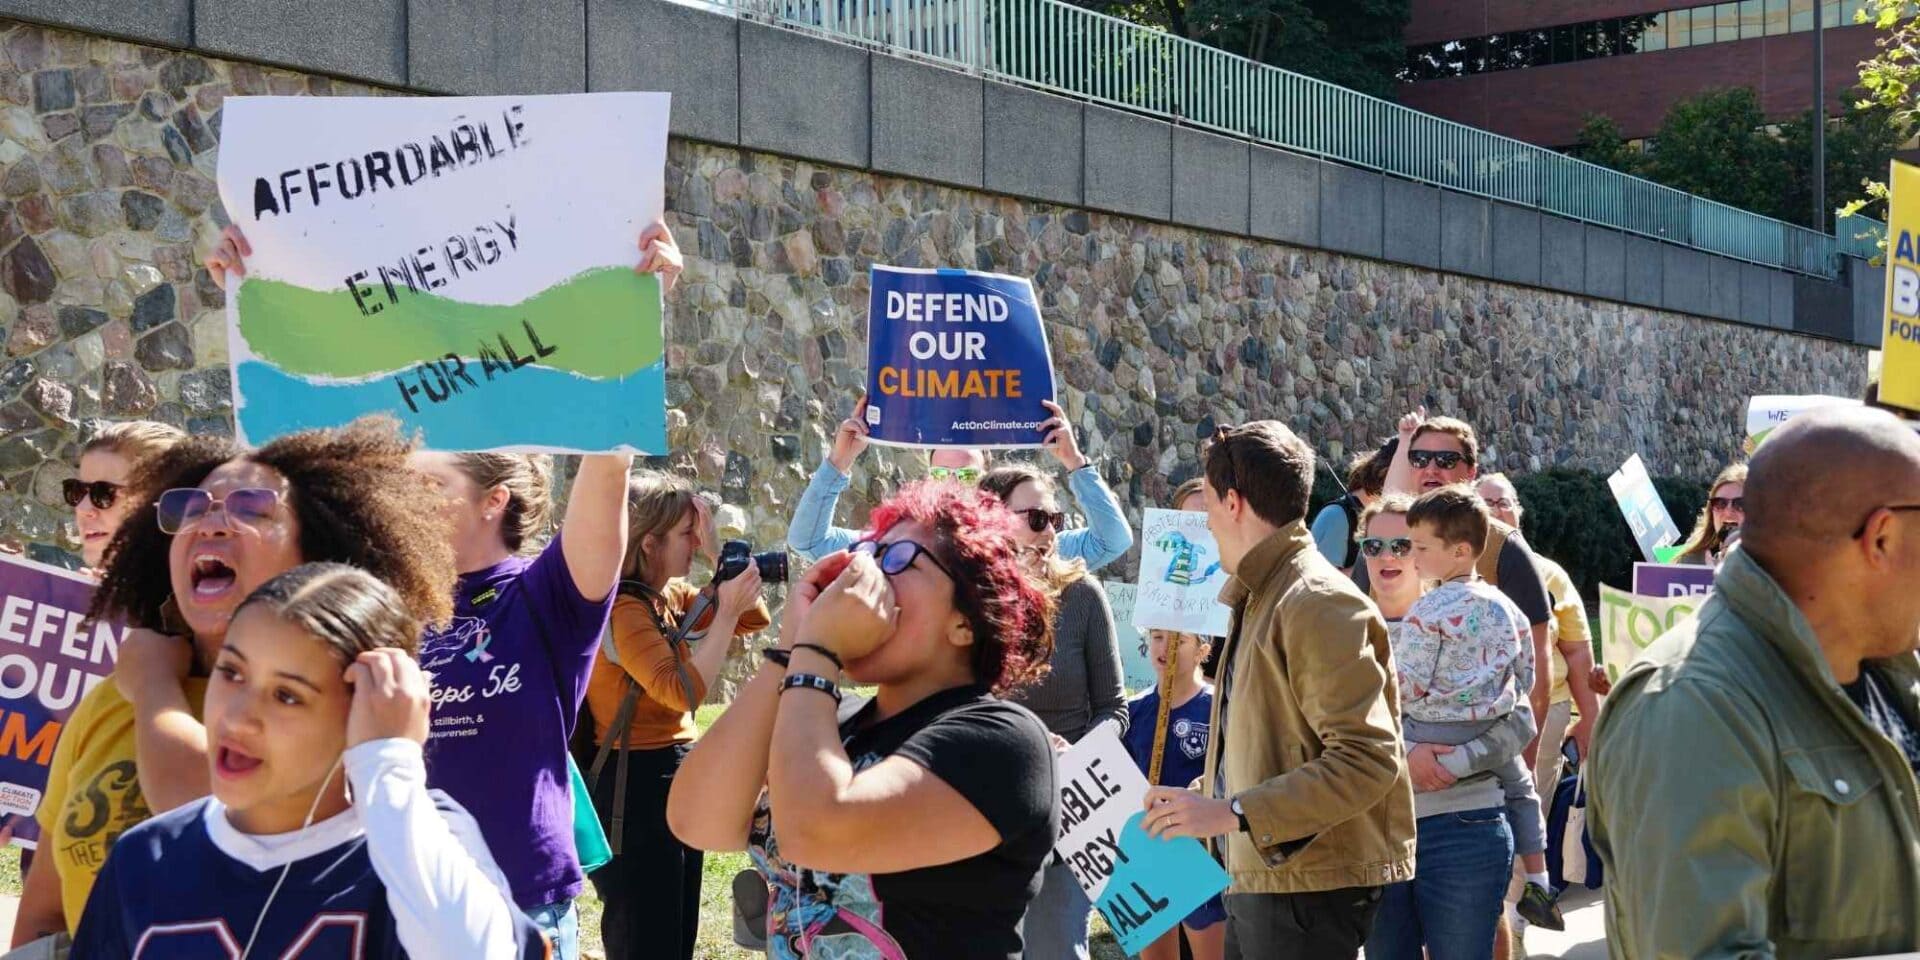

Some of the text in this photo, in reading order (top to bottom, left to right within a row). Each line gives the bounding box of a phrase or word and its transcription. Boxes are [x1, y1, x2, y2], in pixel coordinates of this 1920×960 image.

[253, 105, 531, 221] AFFORDABLE
[344, 213, 520, 317] ENERGY
[1895, 229, 1920, 266] A
[886, 290, 1009, 322] DEFEND
[909, 330, 986, 361] OUR
[394, 319, 558, 413] FOR ALL
[878, 366, 1023, 399] CLIMATE
[482, 662, 523, 698] 5k
[1058, 757, 1122, 841] ABLE
[61, 840, 104, 868] THE
[1107, 881, 1170, 937] ALL
